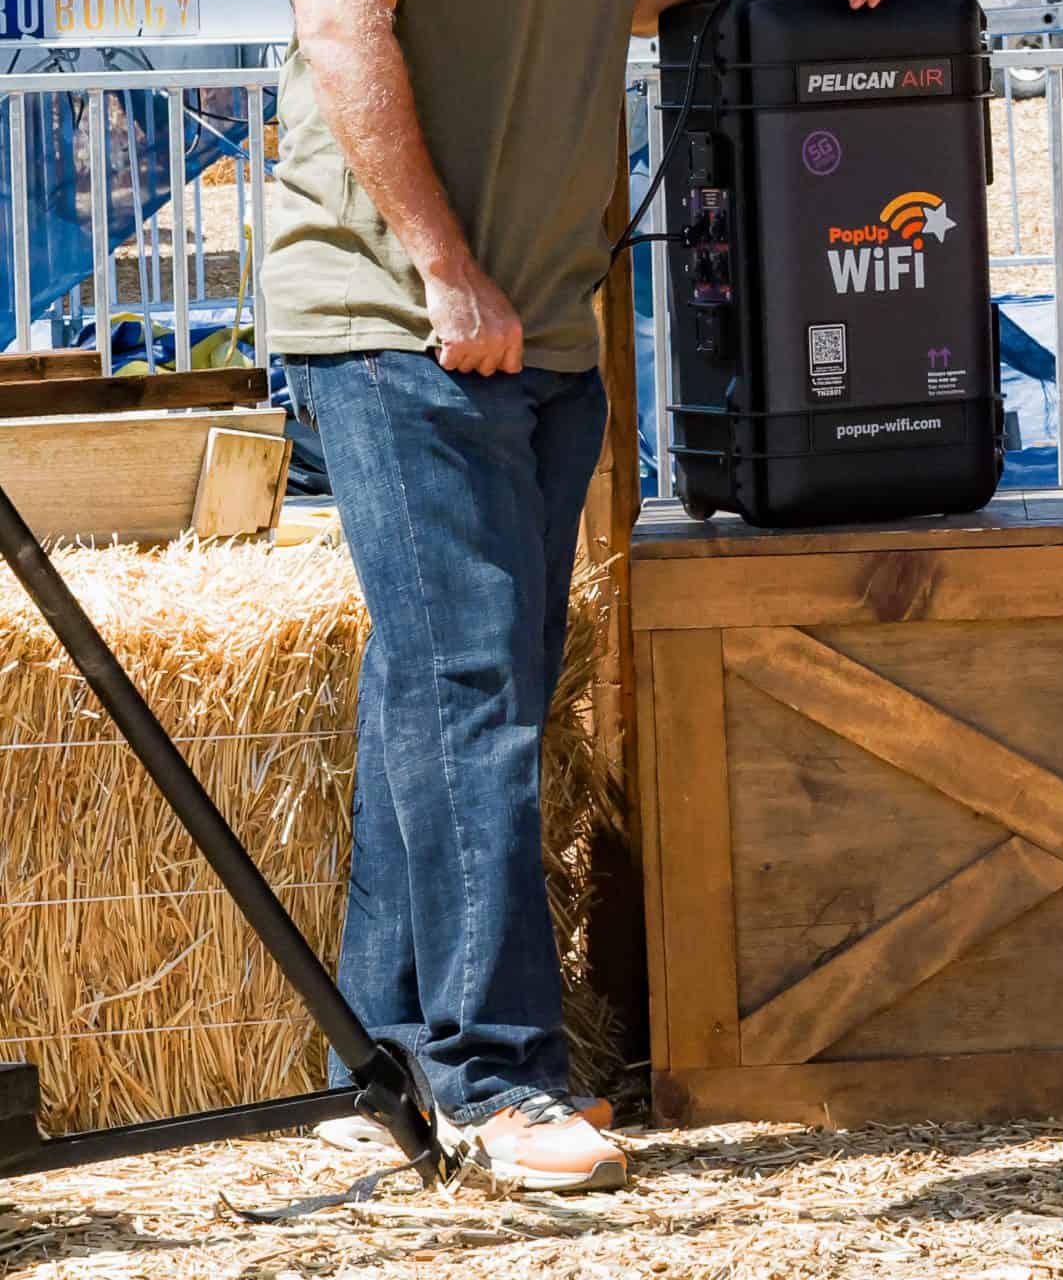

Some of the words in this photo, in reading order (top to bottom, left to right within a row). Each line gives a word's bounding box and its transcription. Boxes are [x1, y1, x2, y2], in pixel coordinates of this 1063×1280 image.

[807, 71, 897, 93] PELICAN
[901, 69, 945, 87] AIR
[808, 137, 833, 161] 5G
[829, 224, 889, 246] PopUp
[827, 238, 926, 294] WiFi
[836, 417, 942, 440] popup-wifi.com
